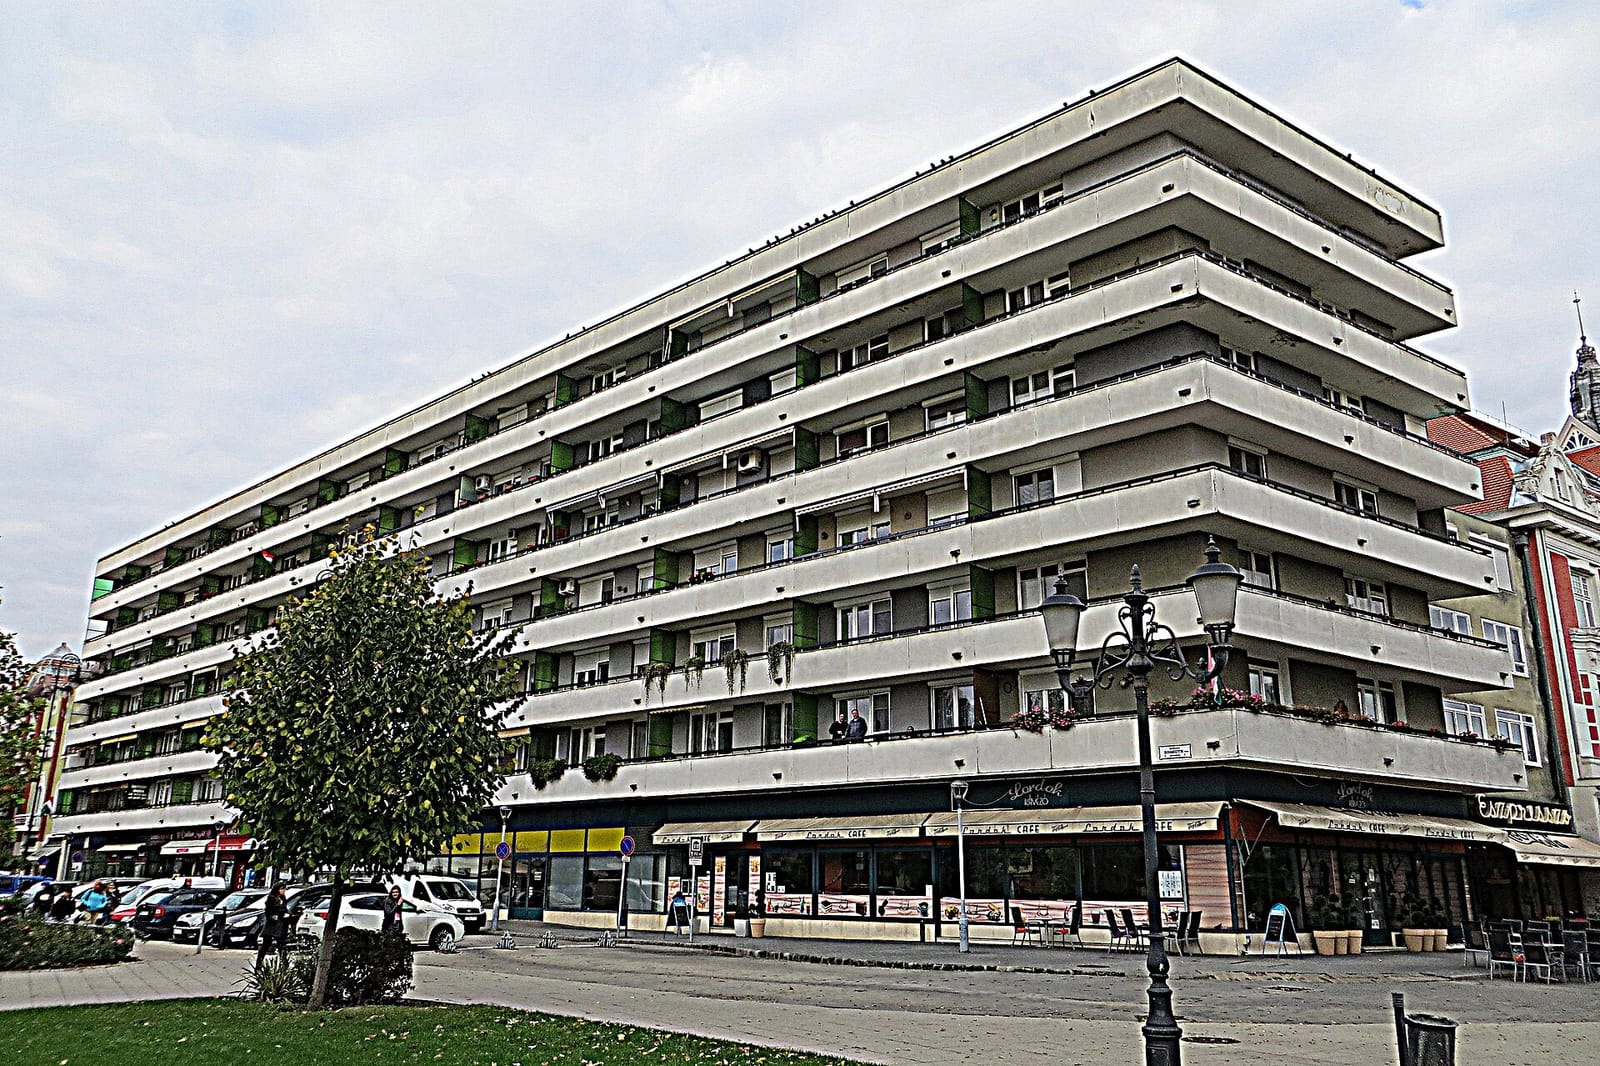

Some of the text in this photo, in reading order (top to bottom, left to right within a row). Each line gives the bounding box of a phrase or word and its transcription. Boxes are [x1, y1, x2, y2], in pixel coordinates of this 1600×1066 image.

[1009, 779, 1063, 800] Lordok
[962, 824, 1040, 835] Lordok CAFE
[1083, 821, 1173, 832] Lordok AFE
[805, 830, 866, 839] Lordok CAFE
